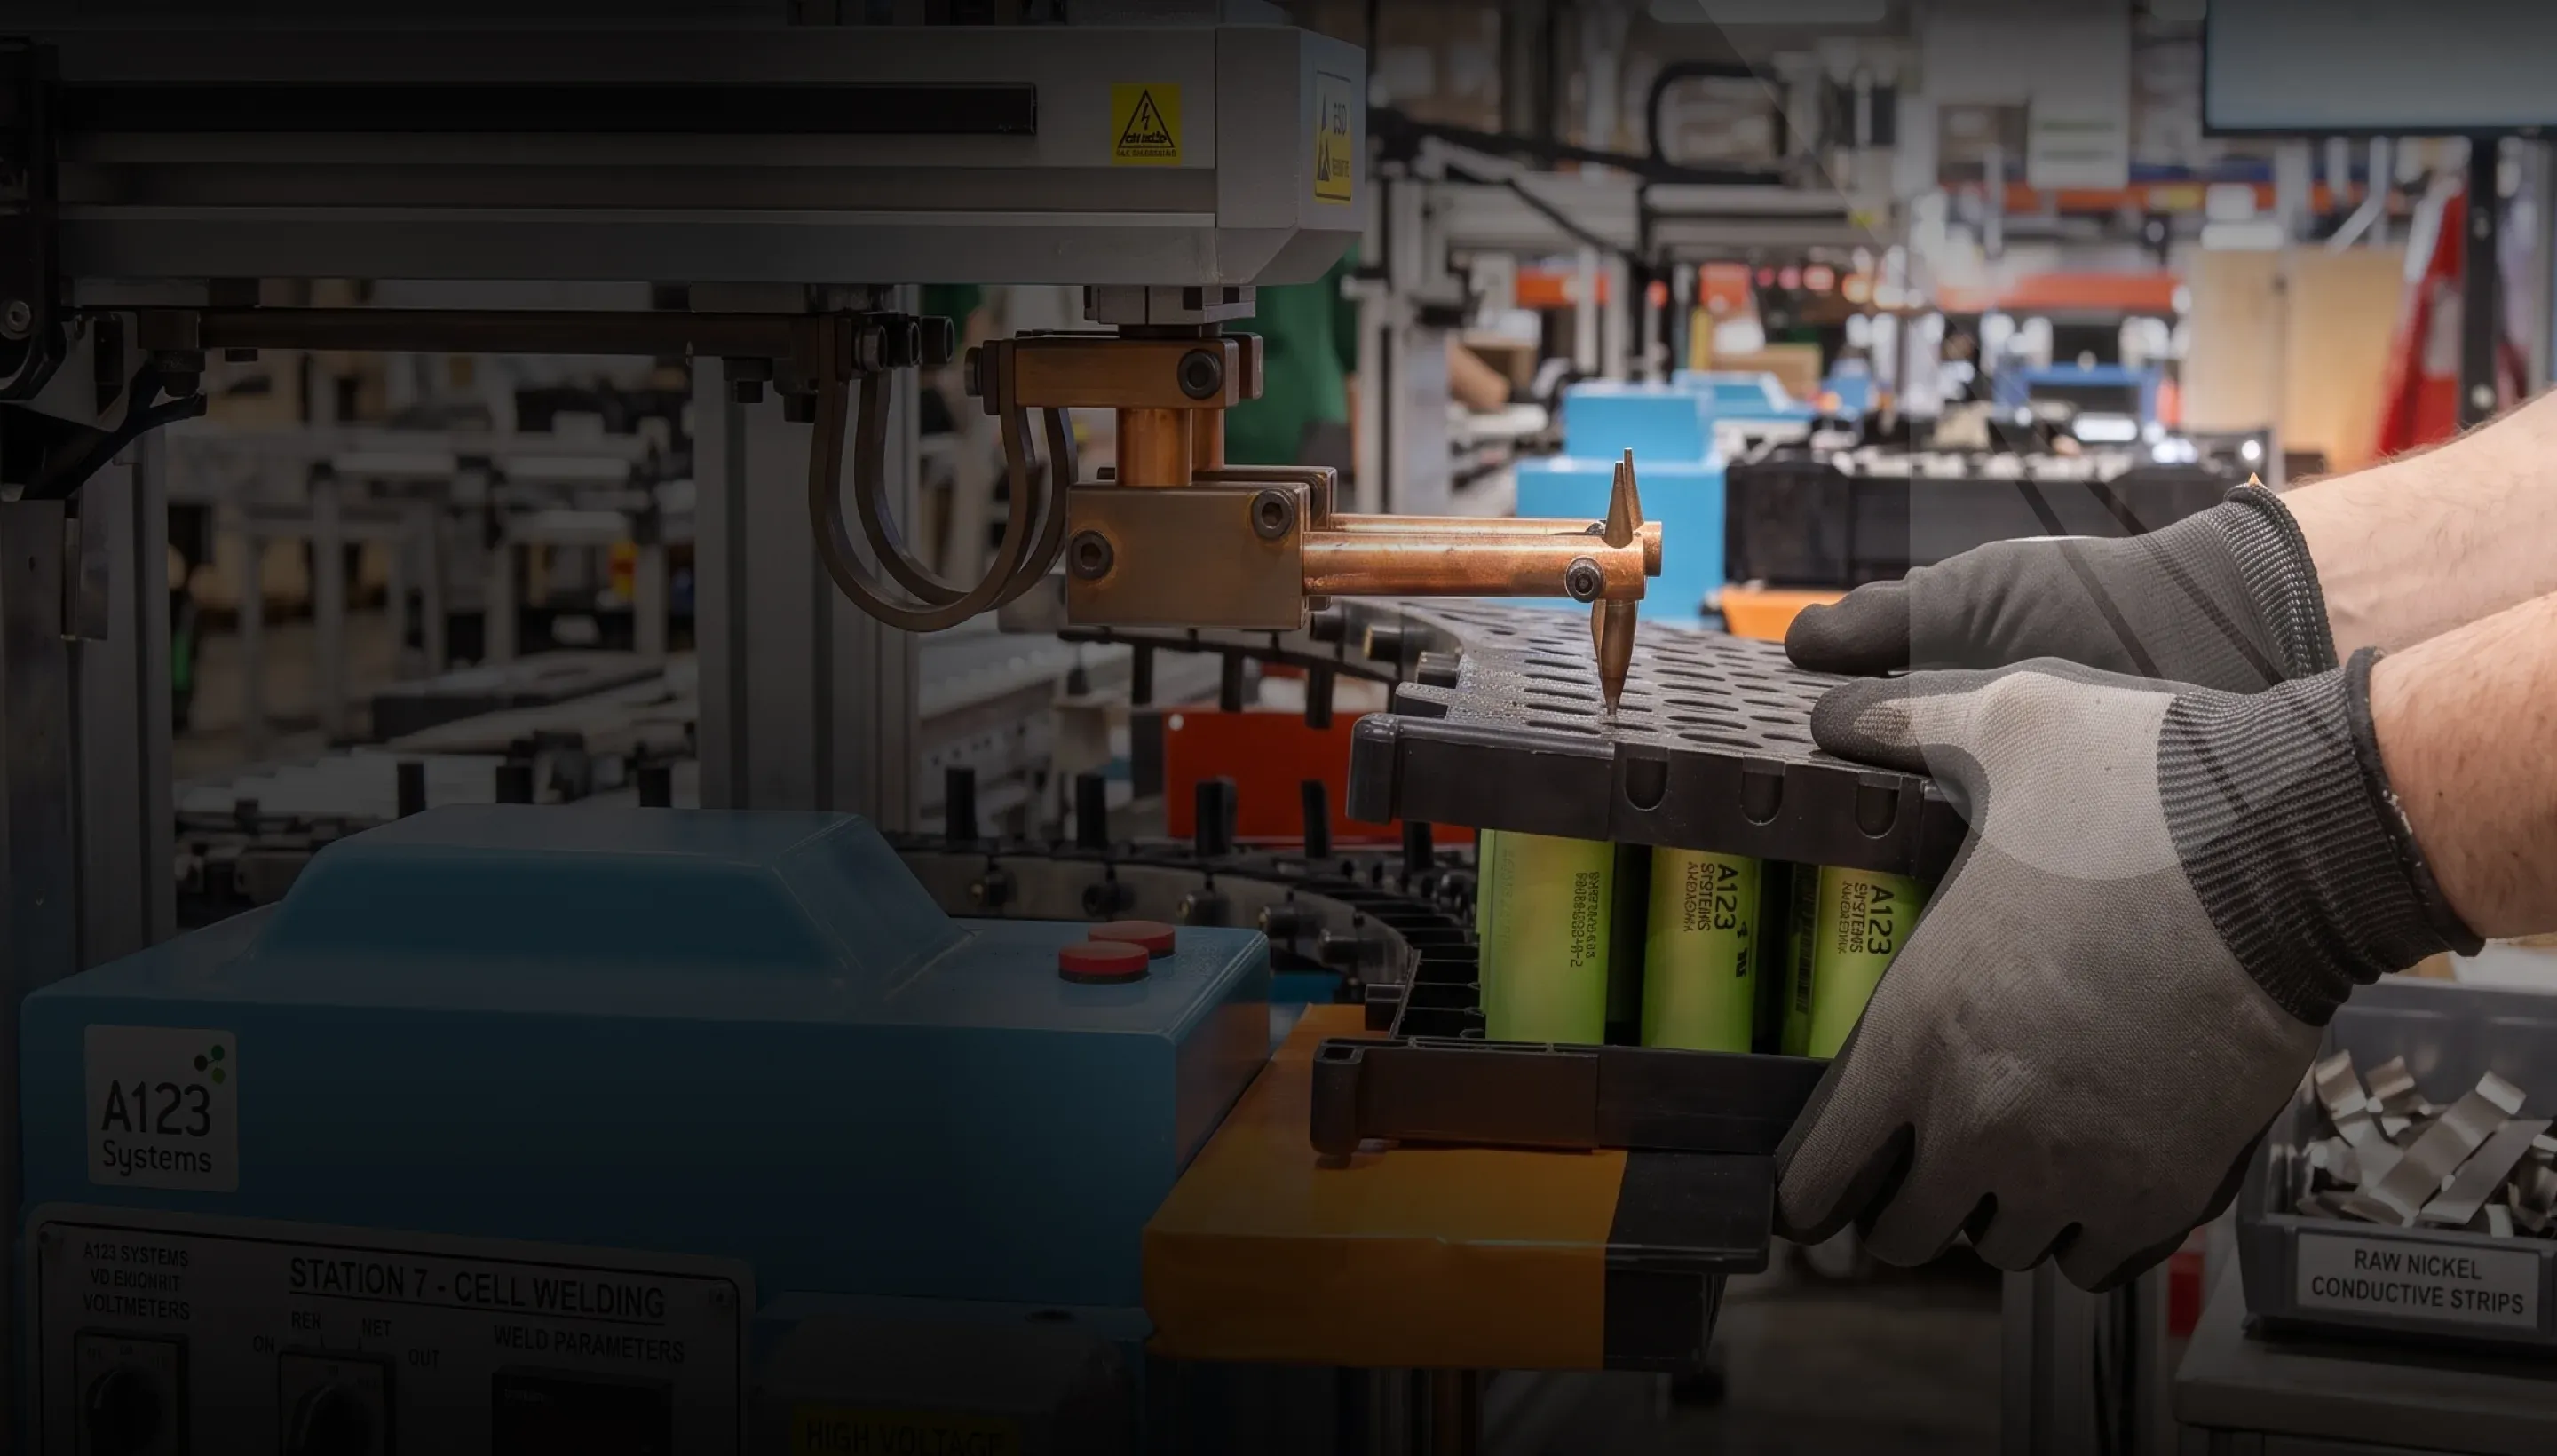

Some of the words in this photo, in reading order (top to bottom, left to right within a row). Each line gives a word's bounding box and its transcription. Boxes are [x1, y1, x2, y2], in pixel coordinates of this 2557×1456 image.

[1714, 864, 1738, 930] A123
[1867, 885, 1894, 955] A123
[101, 1080, 210, 1136] A123
[103, 1140, 211, 1176] Systems
[83, 1242, 116, 1261] A123
[121, 1245, 189, 1268] SYSTEMS
[2355, 1249, 2402, 1272] RAW
[2408, 1254, 2482, 1280] NICKEL
[289, 1257, 403, 1296] STATION
[414, 1268, 429, 1297] 7
[455, 1271, 526, 1307] CELL
[534, 1277, 665, 1318] WELDING
[2312, 1276, 2443, 1306] CONDUCTIVE
[2451, 1289, 2524, 1314] STRIPS
[83, 1294, 190, 1320] VOLTMETERS
[253, 1335, 274, 1354] ON
[361, 1318, 392, 1337] NET
[494, 1325, 548, 1350] WELD
[555, 1332, 685, 1364] PARAMETERS
[806, 1418, 868, 1452] HIGH
